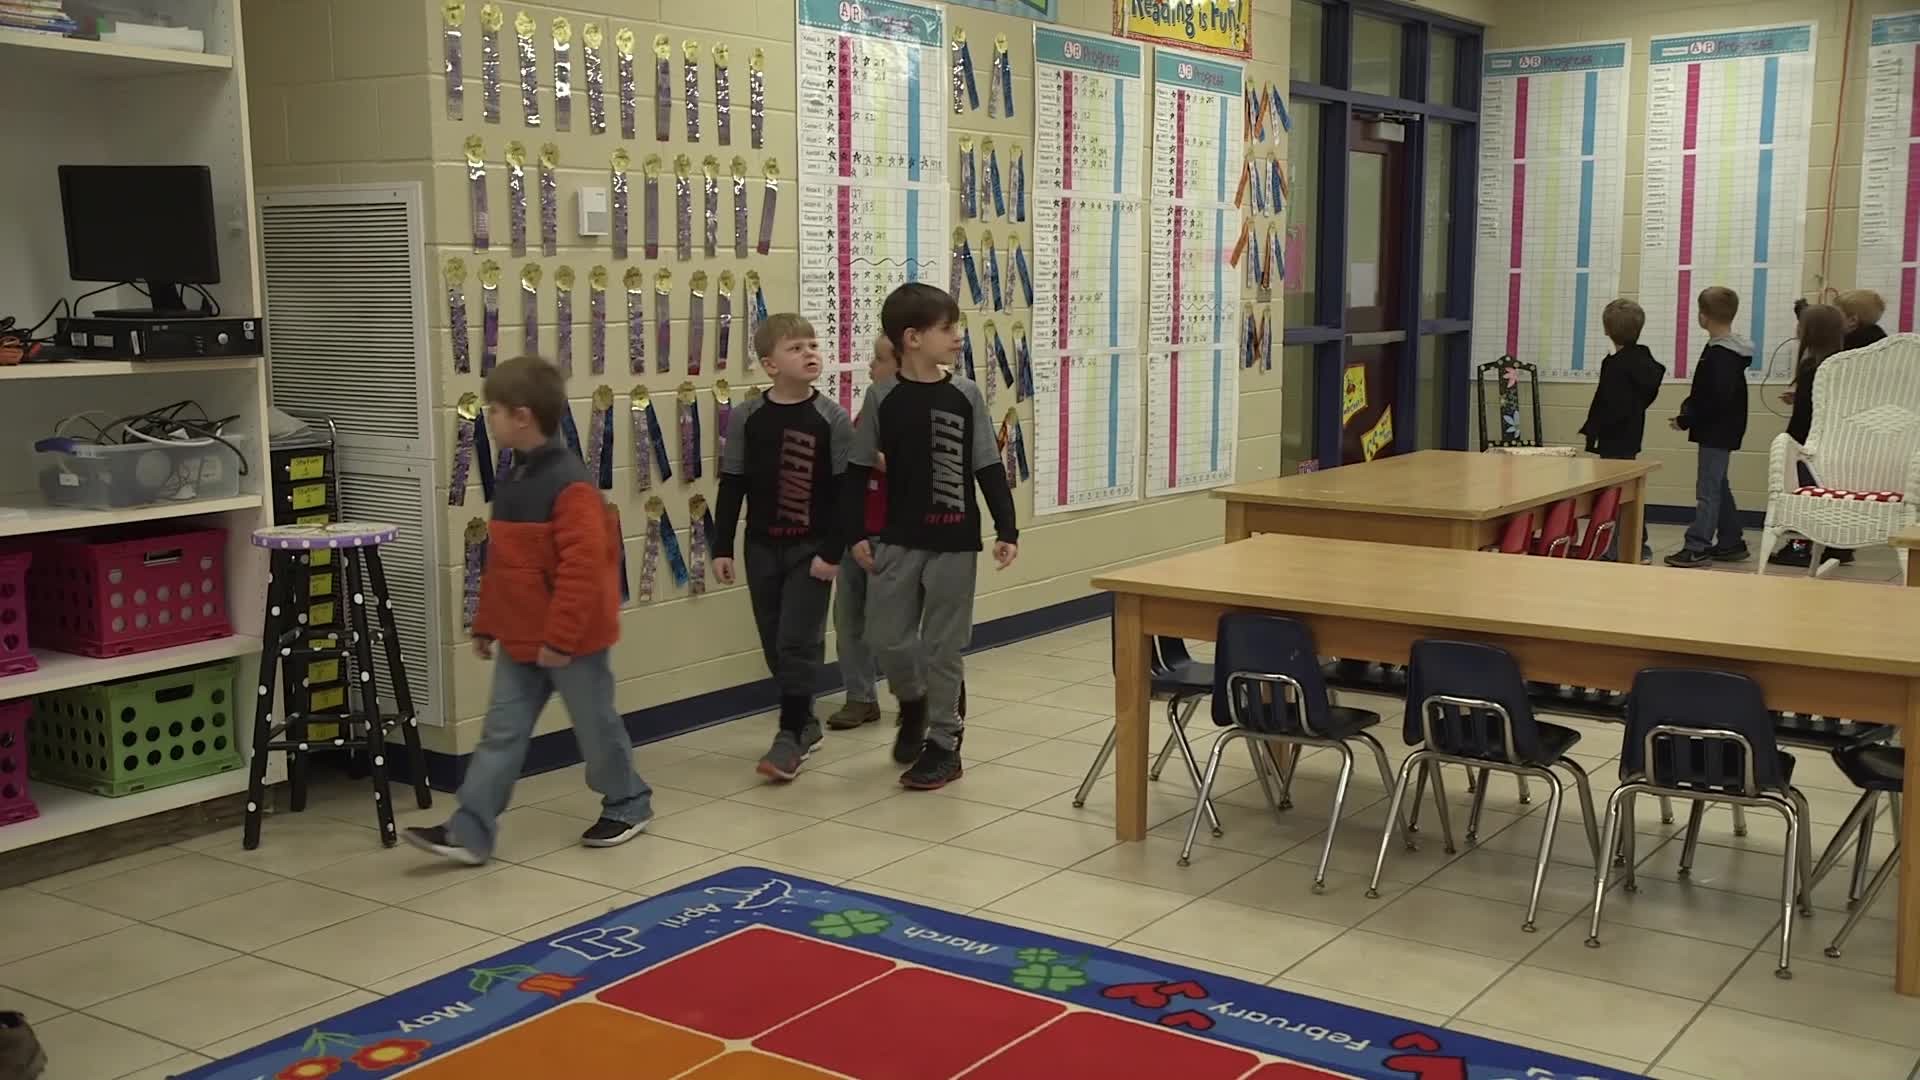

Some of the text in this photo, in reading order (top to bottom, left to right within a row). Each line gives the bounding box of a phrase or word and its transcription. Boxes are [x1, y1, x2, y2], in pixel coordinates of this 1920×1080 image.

[1198, 4, 1208, 31] is
[1543, 54, 1593, 72] Progress
[930, 408, 966, 513] ELEVATE
[776, 427, 817, 528] ELEVATE
[657, 903, 722, 929] April
[903, 926, 1000, 955] March
[396, 1000, 476, 1033] May
[1207, 1000, 1371, 1053] February
